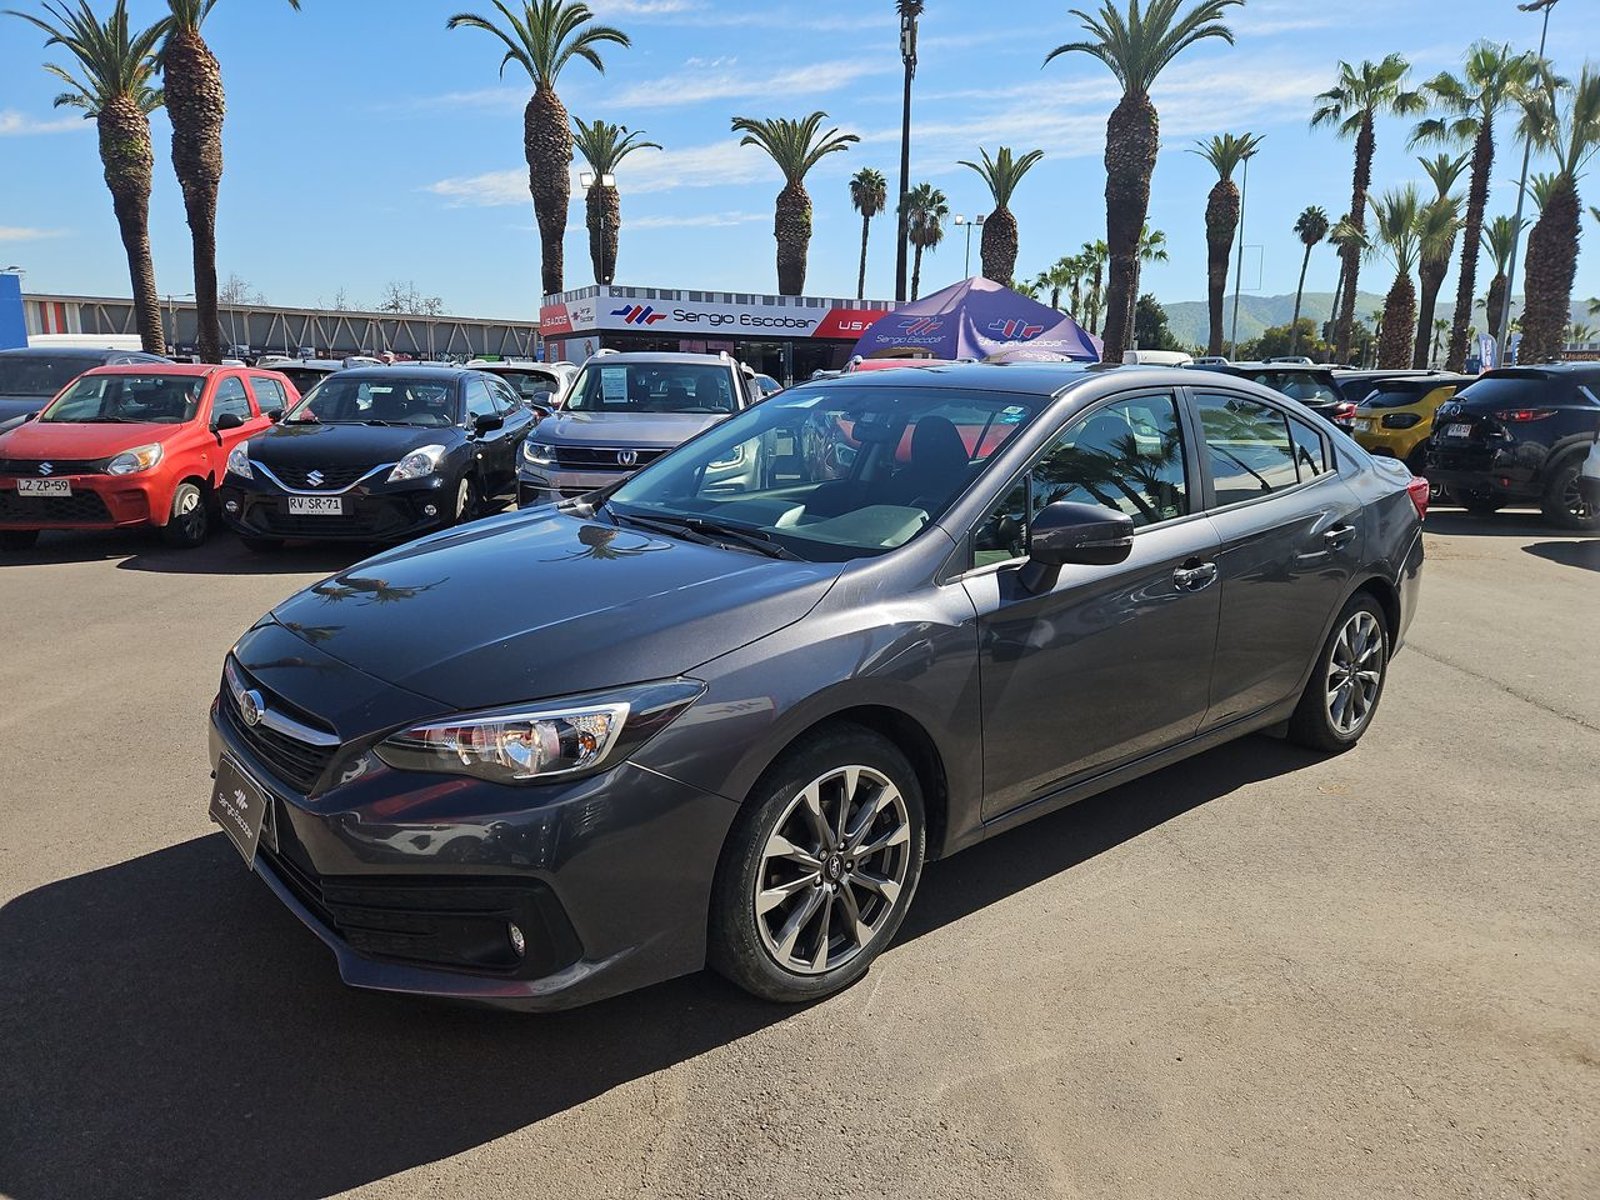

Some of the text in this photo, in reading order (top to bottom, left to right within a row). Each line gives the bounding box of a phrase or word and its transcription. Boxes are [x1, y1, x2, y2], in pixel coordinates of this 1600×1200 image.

[542, 314, 567, 327] USADOS
[672, 309, 818, 329] Sergio Escobar
[907, 335, 946, 345] Escobar
